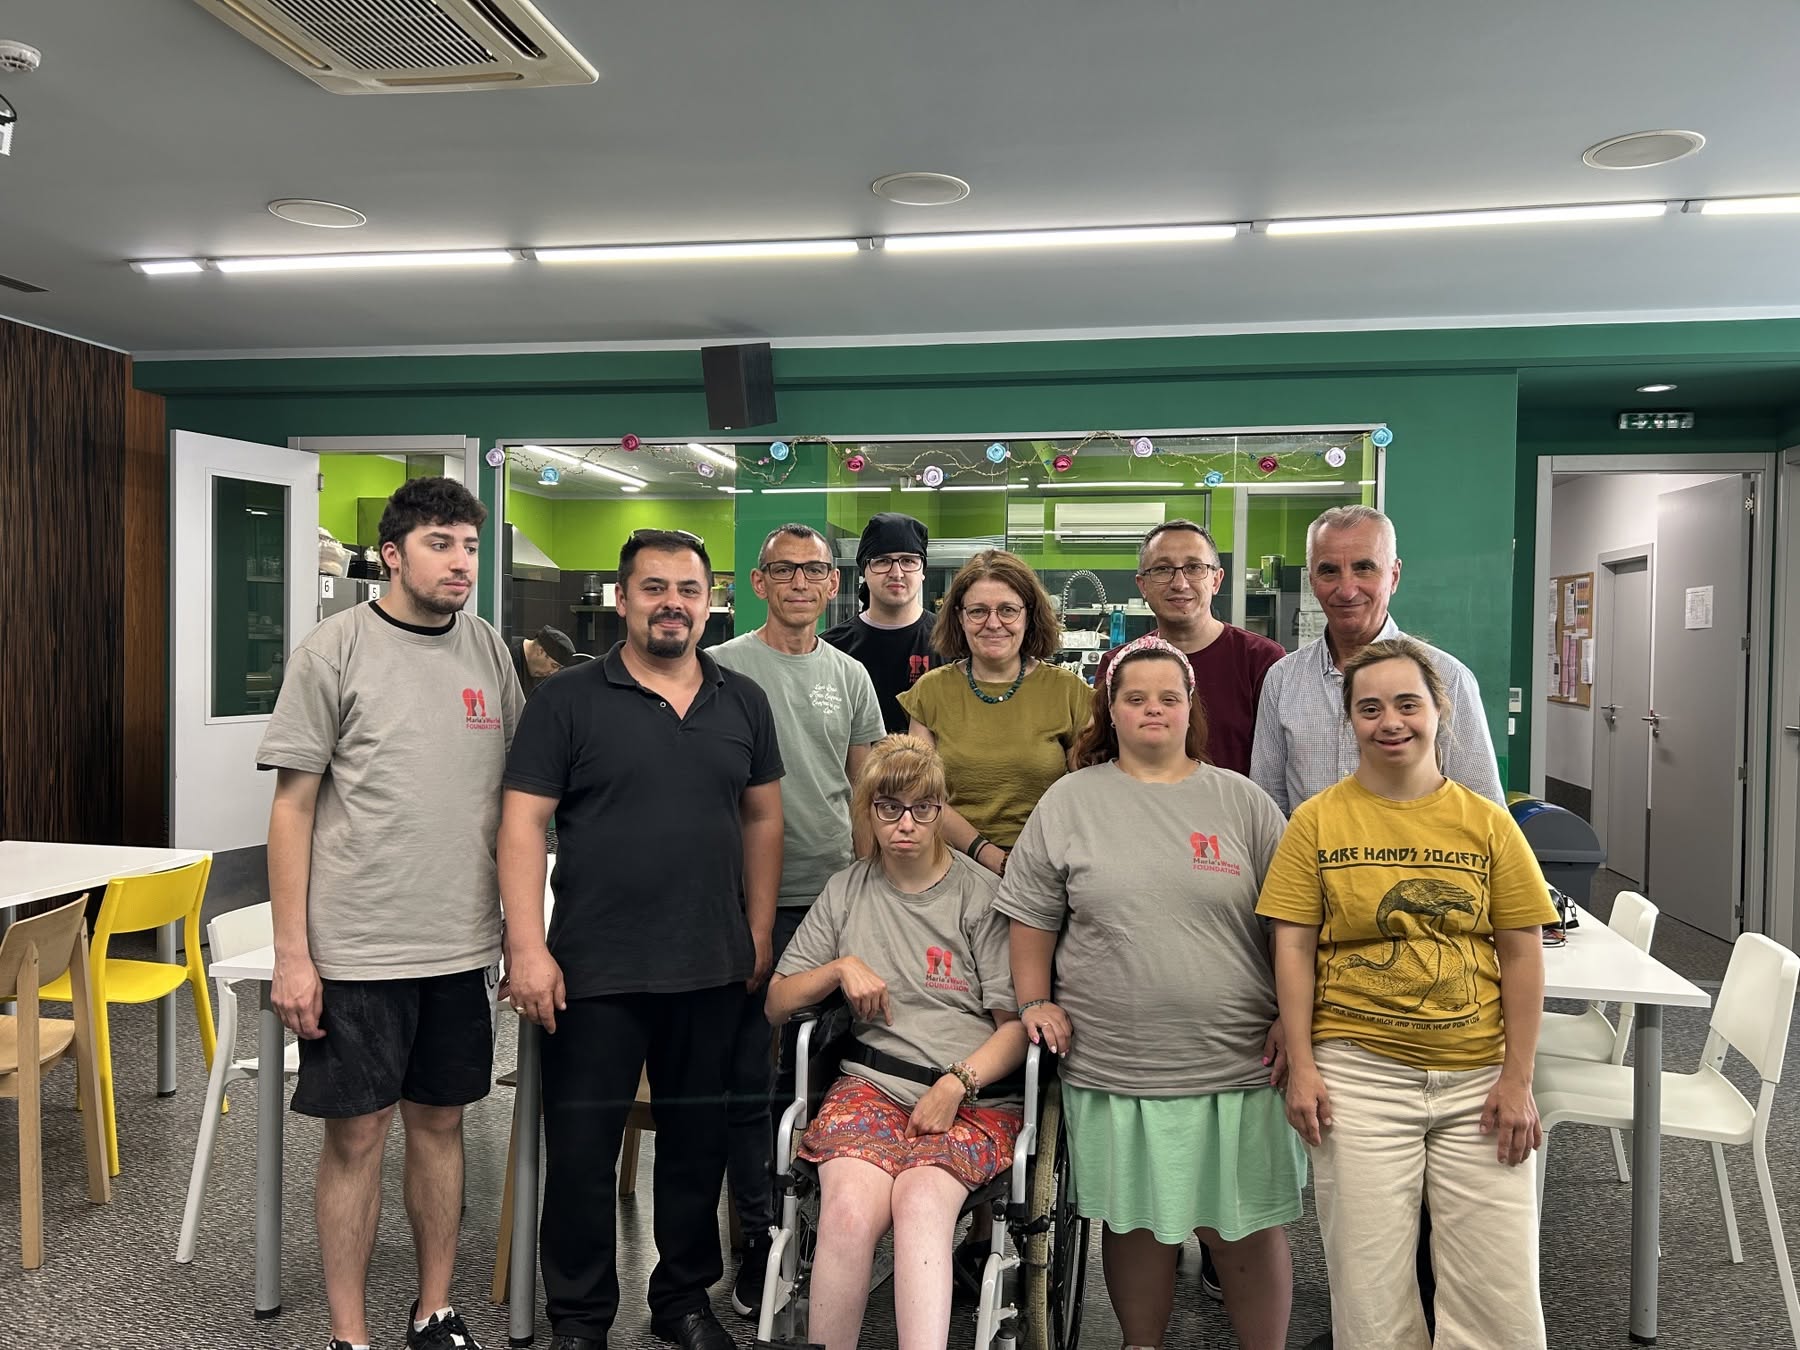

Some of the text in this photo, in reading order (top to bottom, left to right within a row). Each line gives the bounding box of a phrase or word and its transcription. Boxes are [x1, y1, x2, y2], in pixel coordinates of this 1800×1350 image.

[324, 580, 330, 592] 6
[372, 587, 378, 599] 5
[1193, 857, 1241, 871] Maria's World
[1318, 847, 1490, 869] BARE HANDS SOCIETY
[1193, 864, 1241, 876] FOUNDATION
[926, 974, 950, 983] Maria's
[925, 981, 969, 992] FOUNDATION
[1411, 1022, 1432, 1031] YOUR
